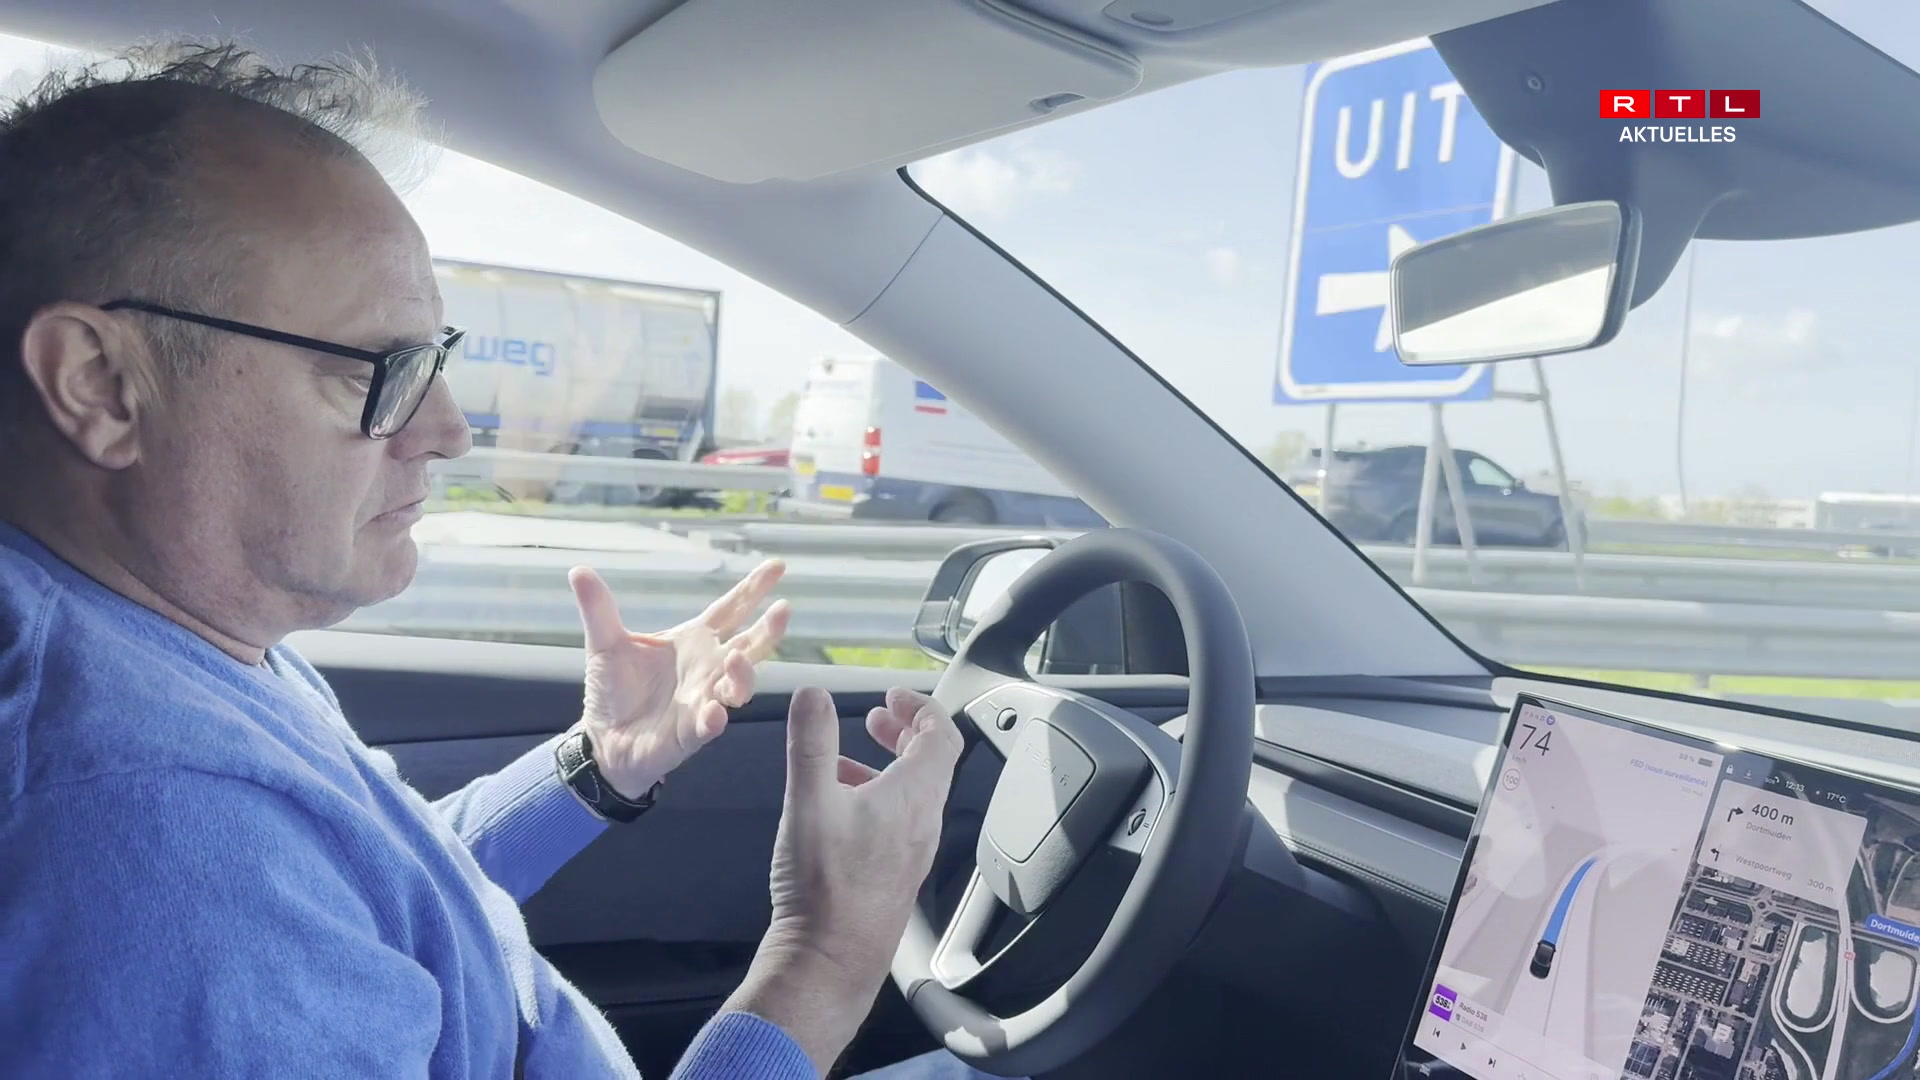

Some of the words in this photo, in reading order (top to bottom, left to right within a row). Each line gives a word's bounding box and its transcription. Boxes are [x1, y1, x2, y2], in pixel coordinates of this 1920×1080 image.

[1335, 80, 1469, 180] UIT
[1519, 723, 1552, 757] 74
[1630, 758, 1645, 769] FSD
[1505, 774, 1519, 786] 100
[1785, 780, 1806, 793] 12:13
[1751, 803, 1779, 821] 400
[1780, 814, 1794, 826] m
[1745, 821, 1792, 842] Dortmuiden
[1735, 855, 1793, 880] Westpoortweg
[1807, 878, 1824, 890] 300
[1825, 886, 1834, 894] m
[1870, 918, 1920, 943] Dortmuide
[1459, 1001, 1476, 1016] Radio
